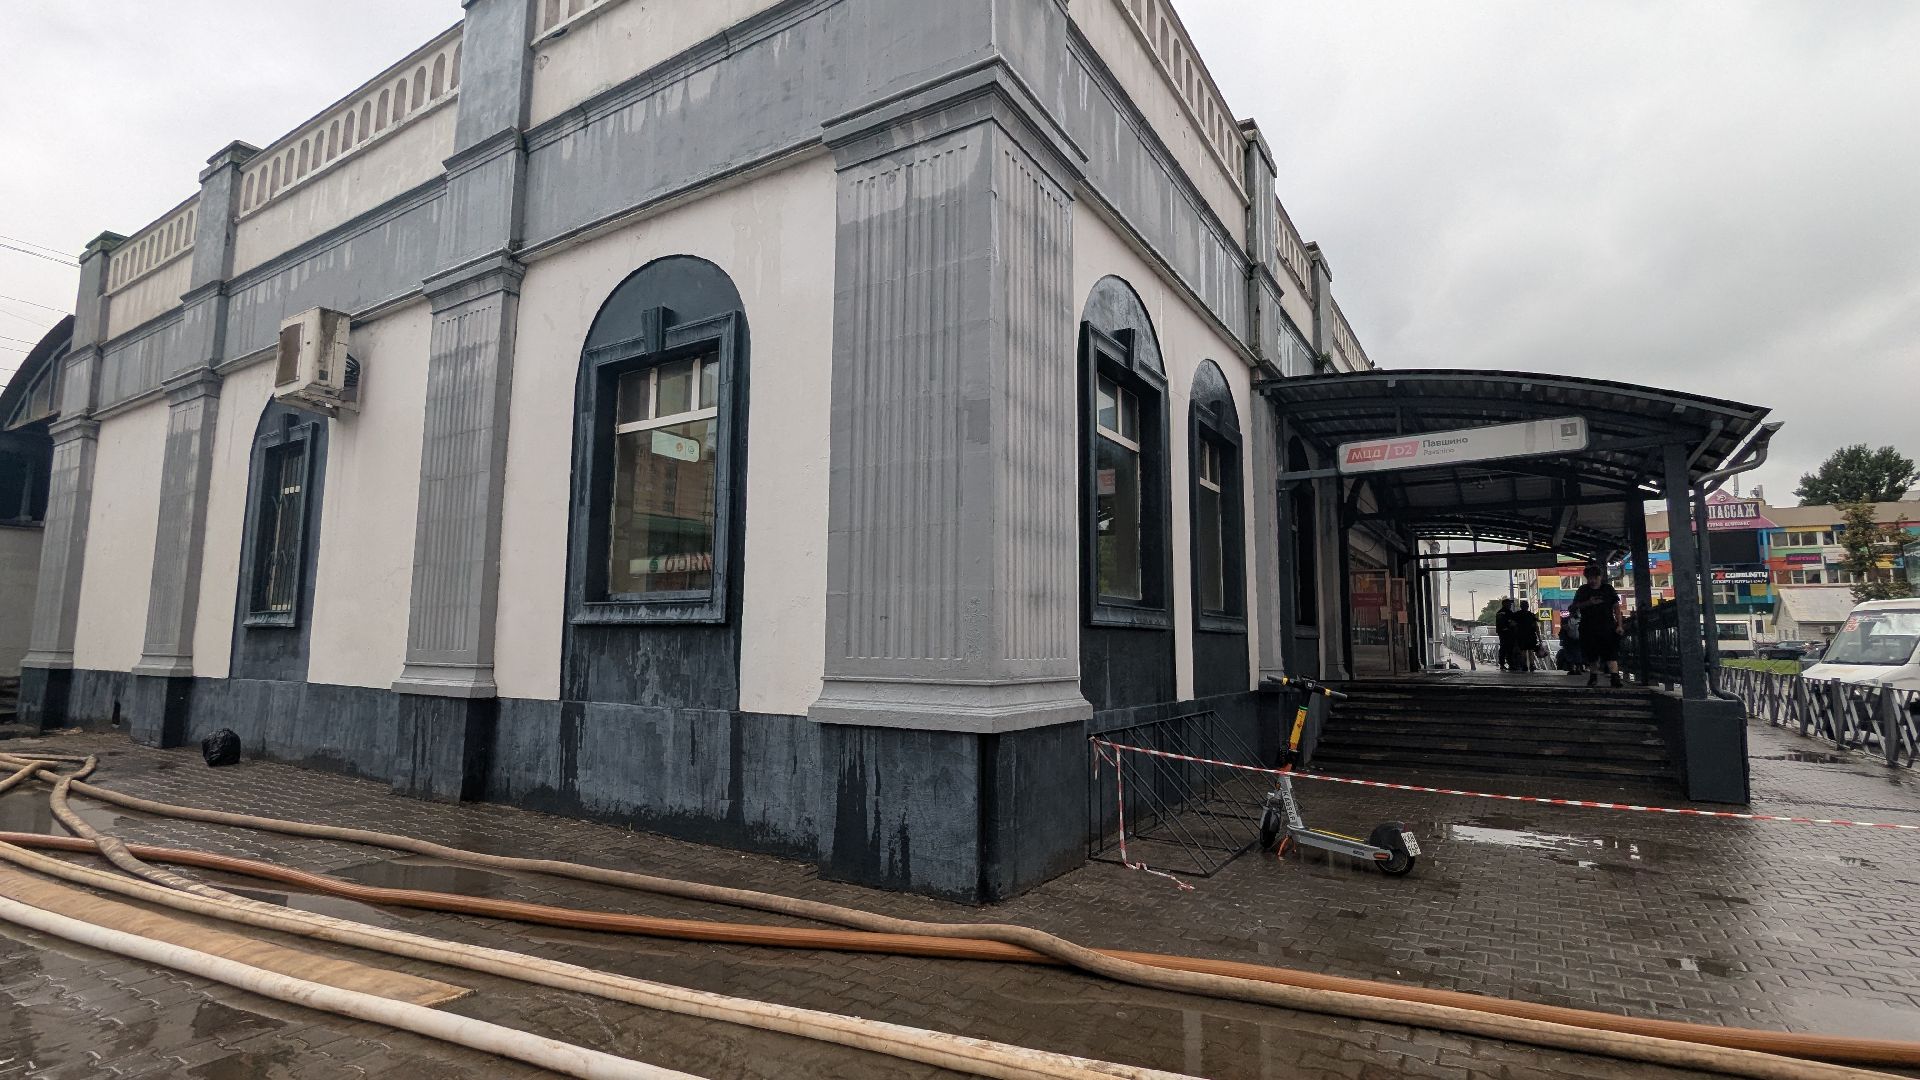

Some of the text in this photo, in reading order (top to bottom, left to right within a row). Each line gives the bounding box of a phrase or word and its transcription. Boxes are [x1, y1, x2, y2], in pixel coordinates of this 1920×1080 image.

[1351, 437, 1469, 460] МЦД D2 Павшино
[1708, 503, 1757, 519] ПАССАЖ
